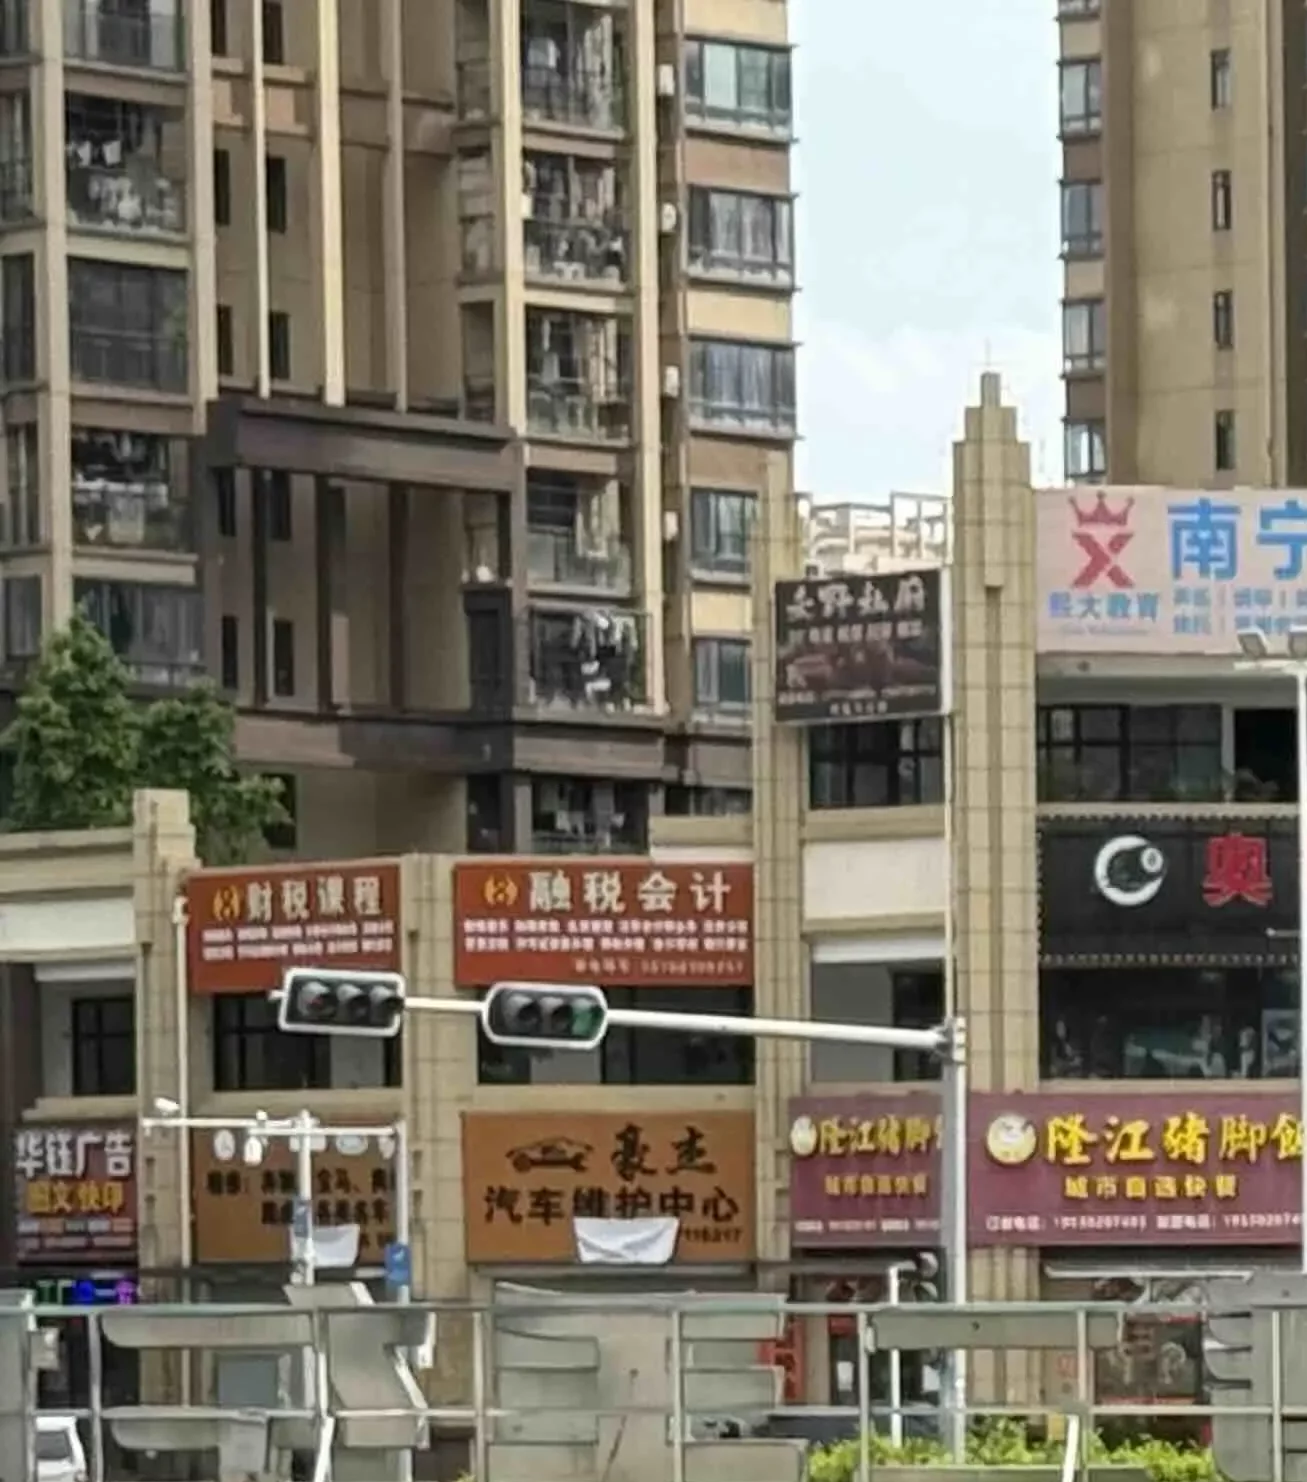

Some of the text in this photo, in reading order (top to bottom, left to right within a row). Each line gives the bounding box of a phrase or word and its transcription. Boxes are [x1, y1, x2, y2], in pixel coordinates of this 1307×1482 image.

[529, 869, 732, 913] 融税会计
[819, 1115, 943, 1157] 隆江猪脚
